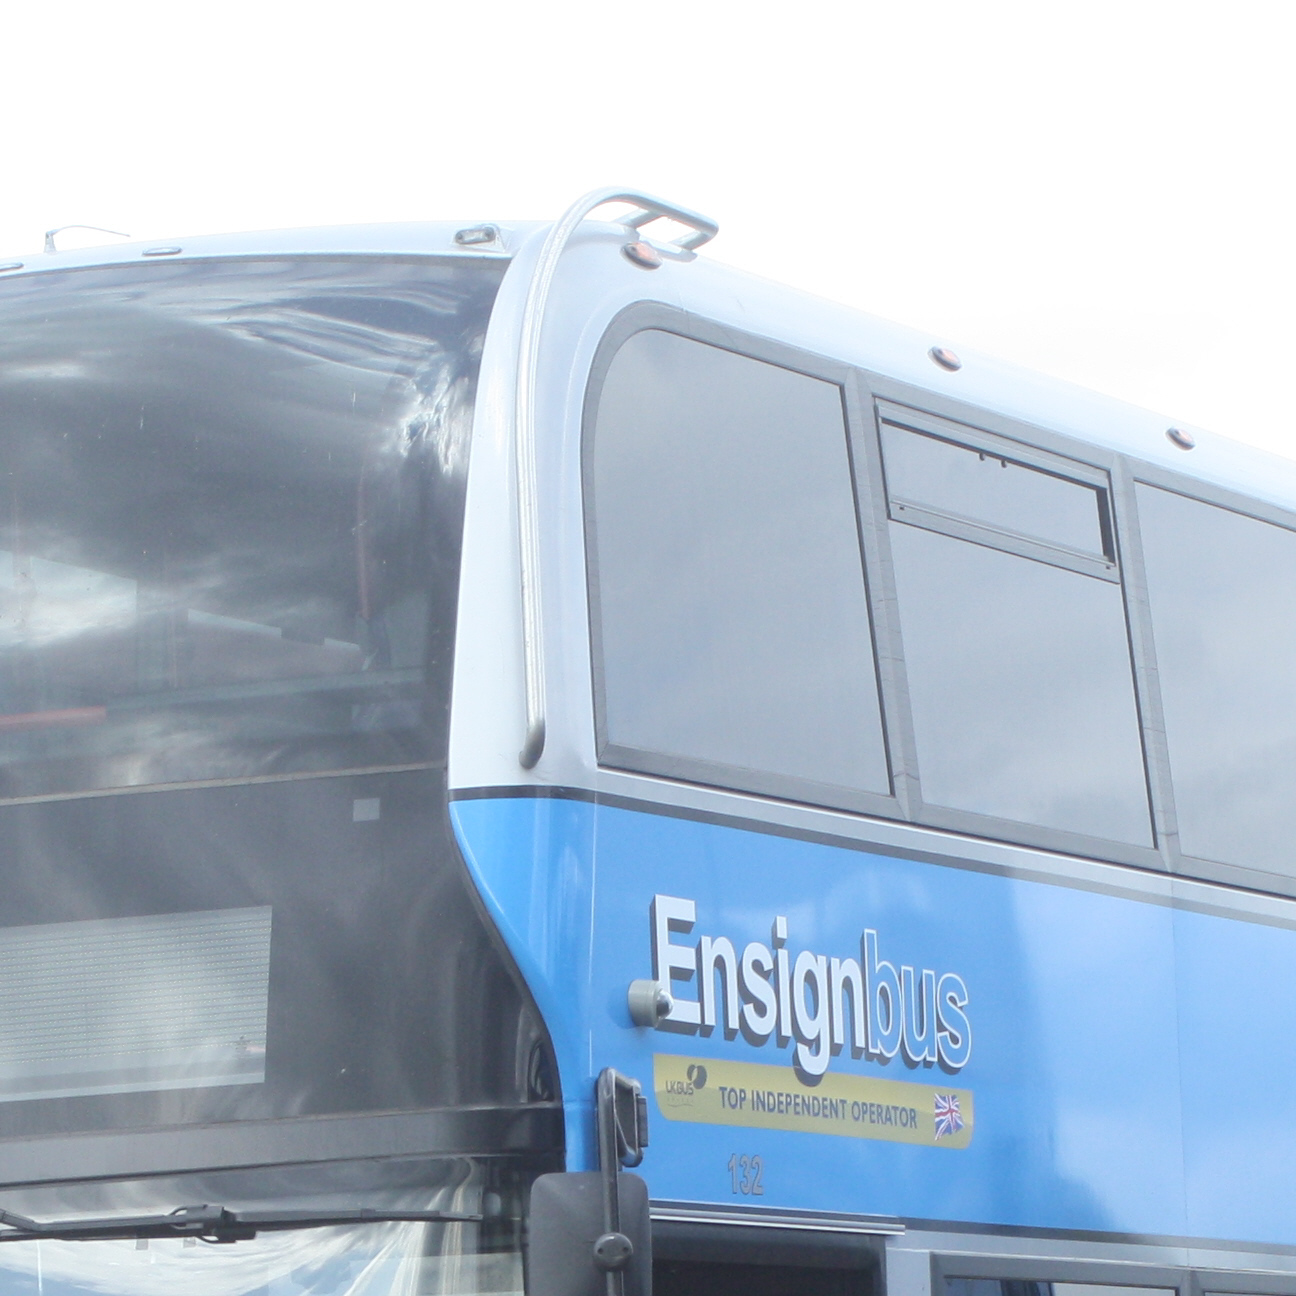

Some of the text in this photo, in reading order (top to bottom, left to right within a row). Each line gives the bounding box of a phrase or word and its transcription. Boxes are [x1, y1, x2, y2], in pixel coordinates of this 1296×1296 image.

[649, 893, 972, 1087] Ensignbus
[719, 1086, 918, 1129] TOP INDEPENDENT OPERATOR
[727, 1153, 764, 1196] 132
